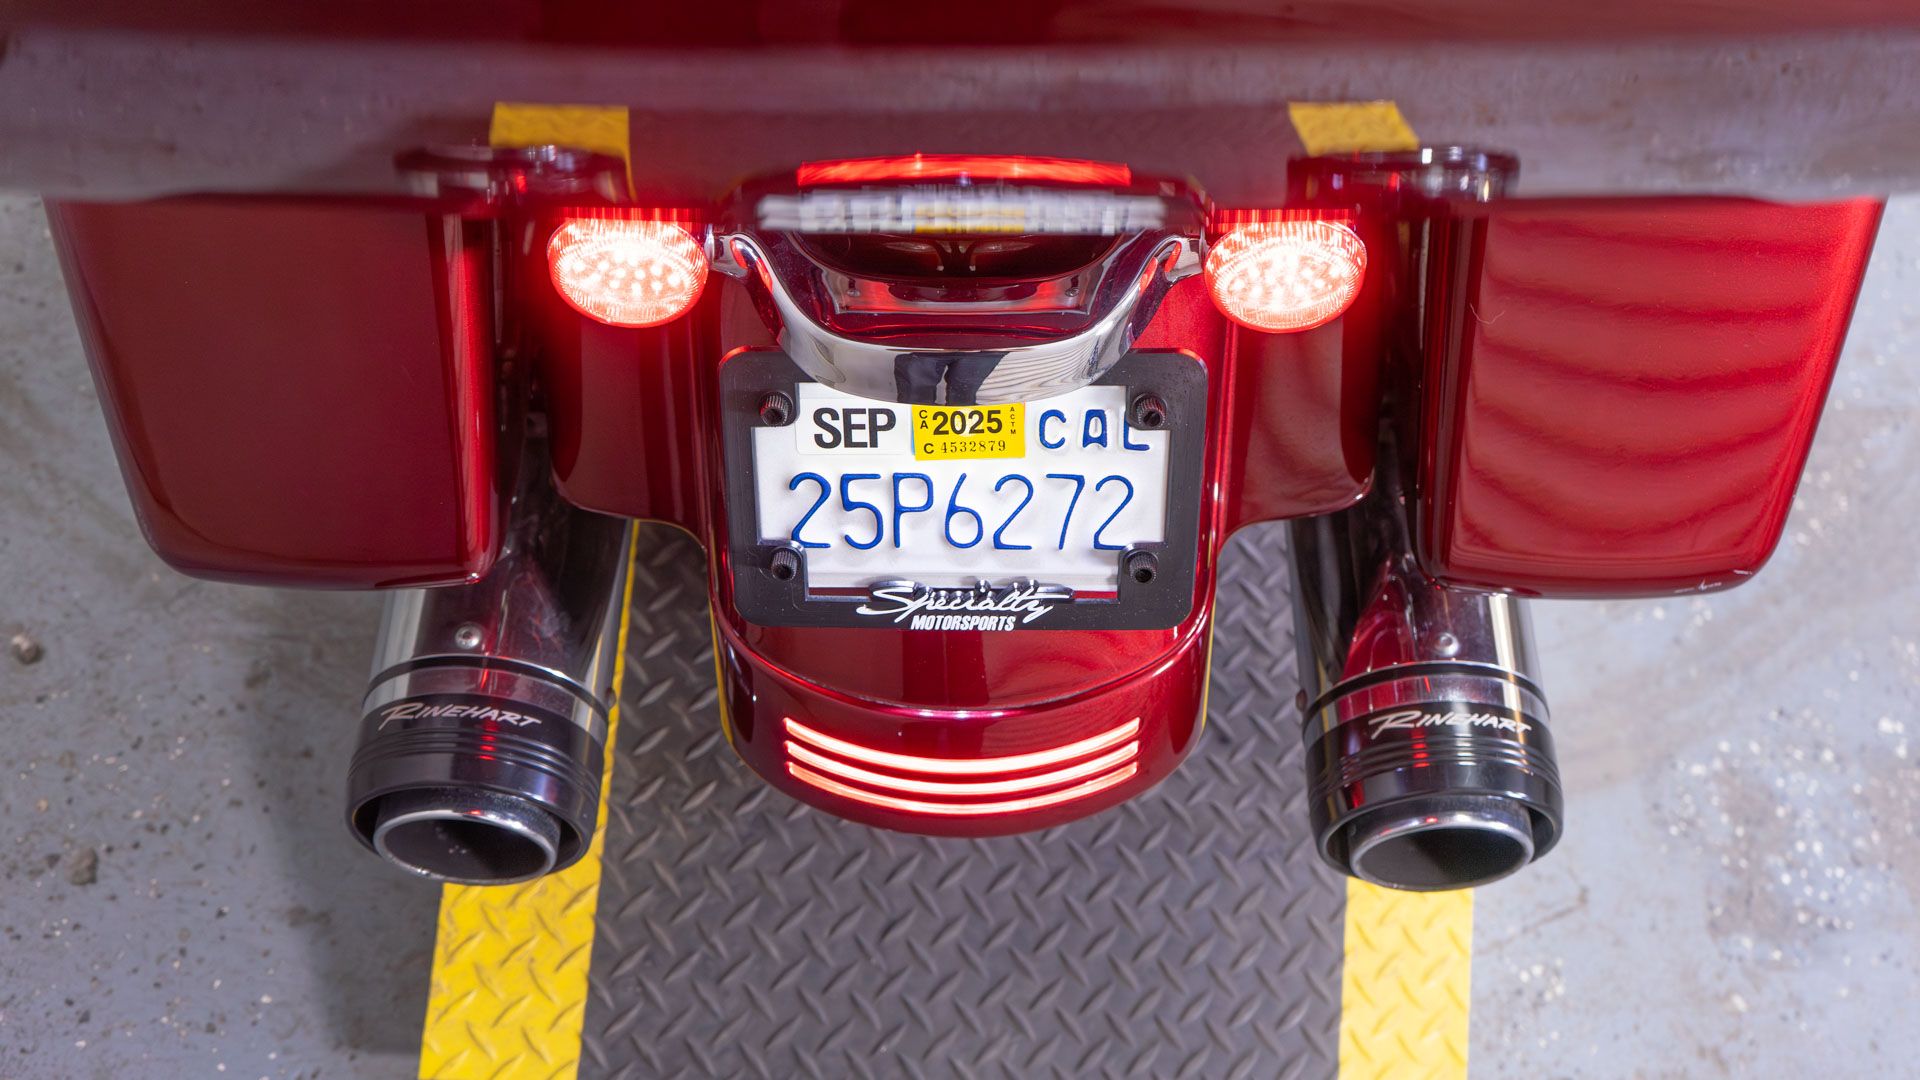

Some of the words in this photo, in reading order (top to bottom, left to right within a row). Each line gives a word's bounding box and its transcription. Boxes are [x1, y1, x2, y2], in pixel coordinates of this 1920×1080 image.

[813, 407, 897, 449] SEP
[932, 409, 1003, 435] 2025
[941, 440, 1006, 453] 4532879
[789, 473, 1134, 550] 25P6272
[856, 582, 1072, 624] Specialty
[910, 614, 1017, 632] MOTORSPORTS
[378, 702, 542, 731] RINEHART
[1368, 710, 1532, 740] RINEHART
